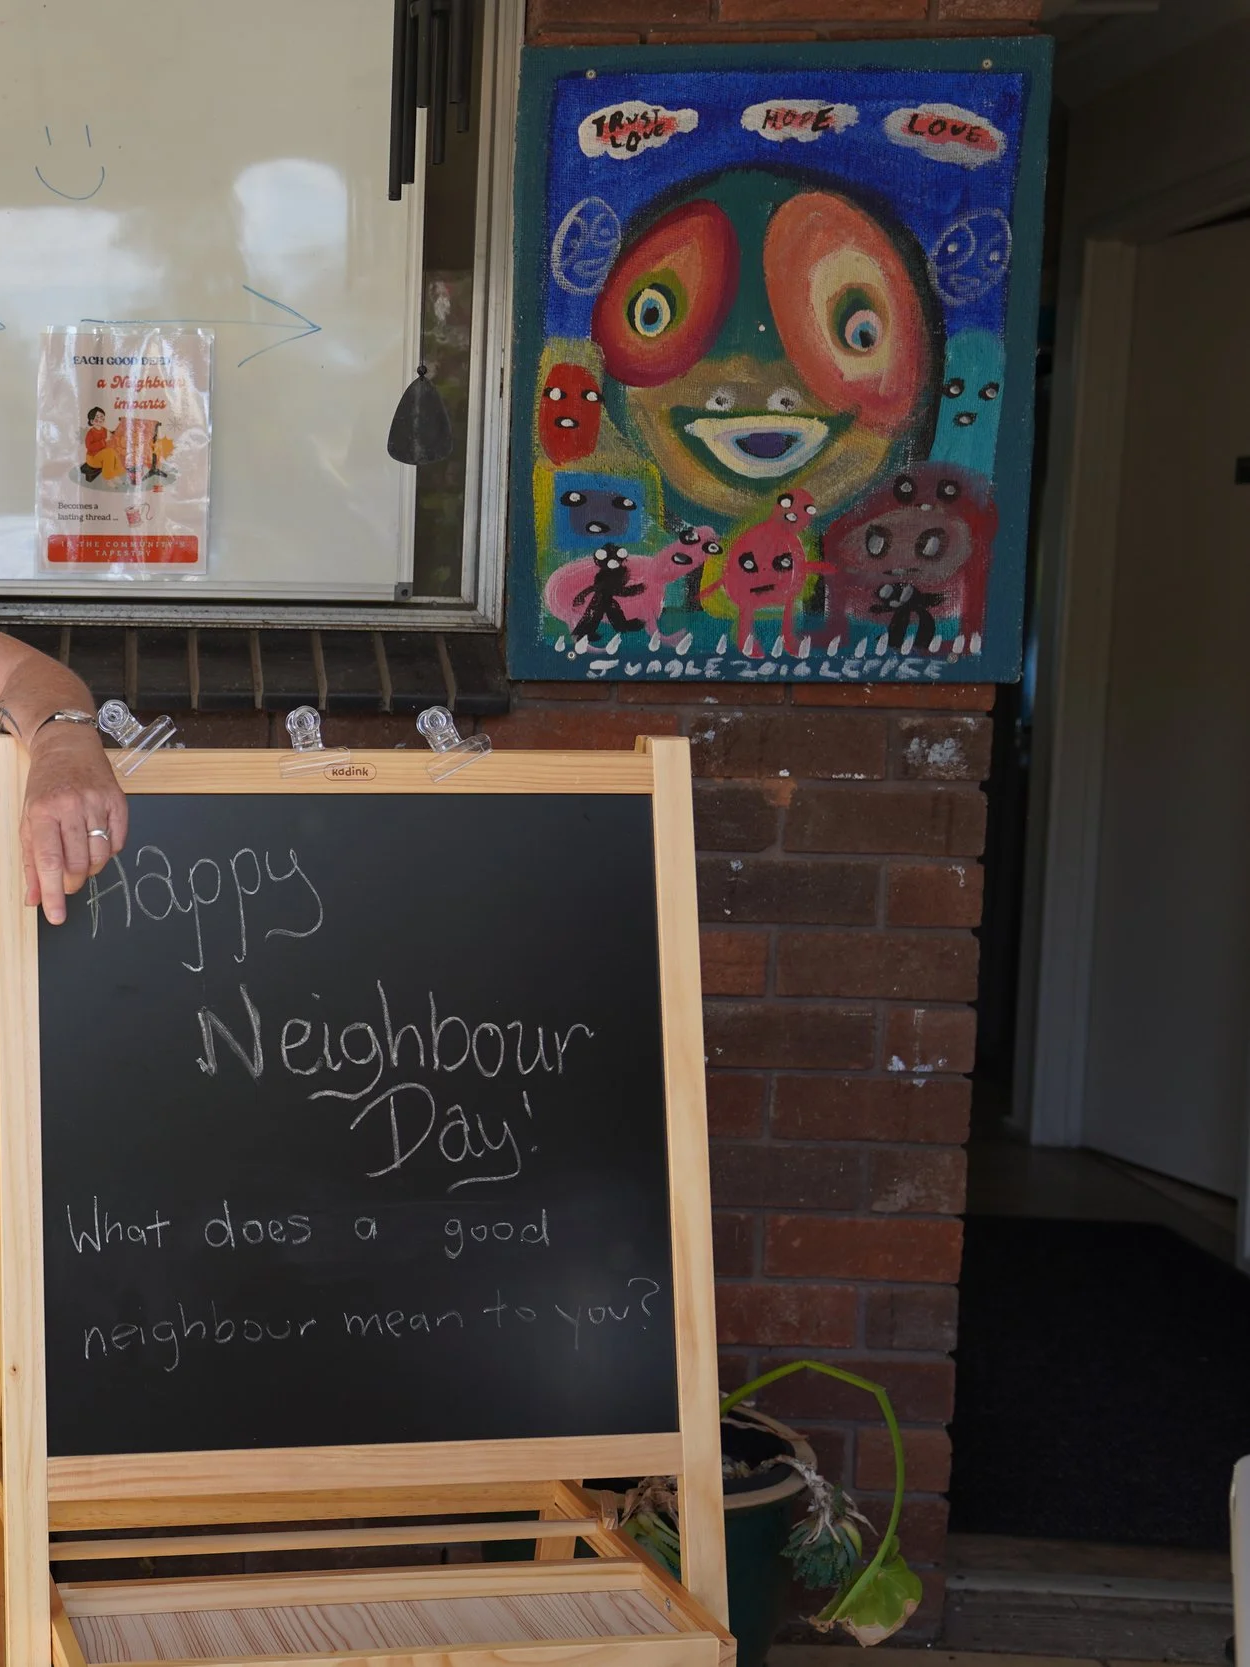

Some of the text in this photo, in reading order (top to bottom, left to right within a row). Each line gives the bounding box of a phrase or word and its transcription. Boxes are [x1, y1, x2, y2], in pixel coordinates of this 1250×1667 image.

[761, 106, 835, 132] HOPE
[73, 356, 104, 366] EACH
[97, 379, 106, 389] a
[57, 513, 84, 523] lasting
[58, 502, 93, 510] Becomes
[87, 845, 323, 972] Happy
[195, 979, 594, 1101] Neighbour
[67, 1195, 550, 1259] What does a good
[84, 1277, 660, 1372] neighbour mean to you?
